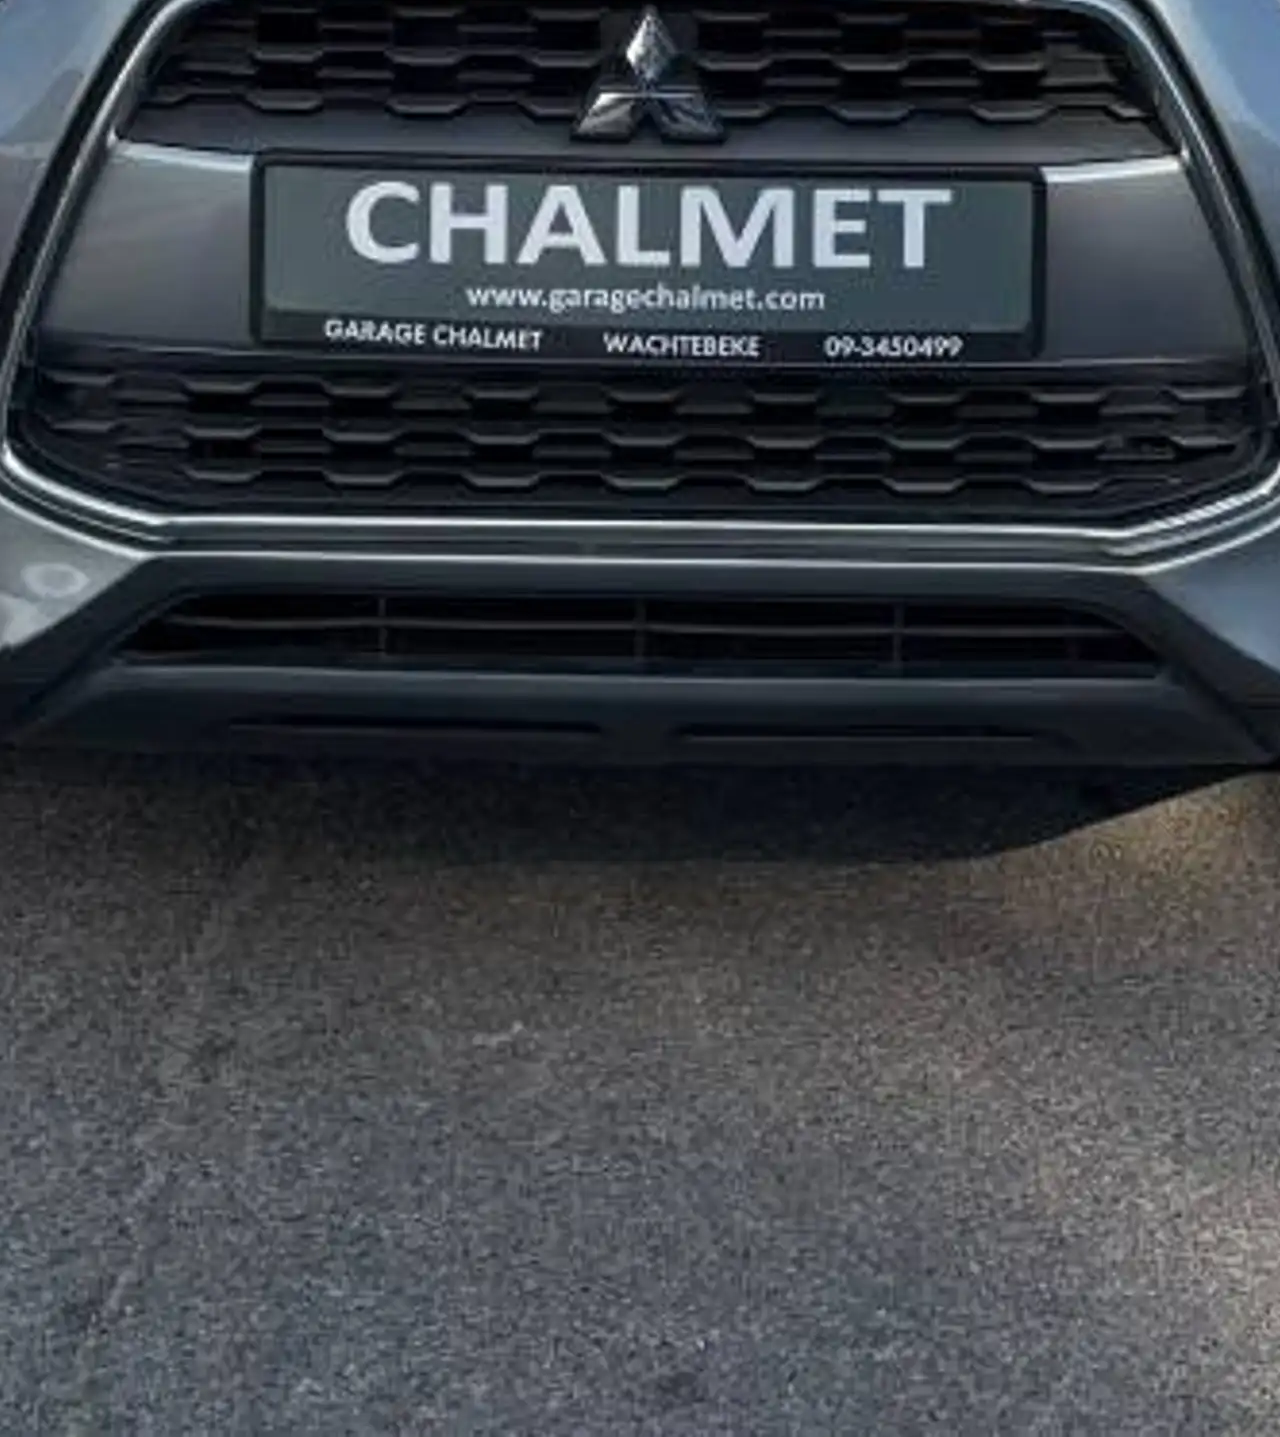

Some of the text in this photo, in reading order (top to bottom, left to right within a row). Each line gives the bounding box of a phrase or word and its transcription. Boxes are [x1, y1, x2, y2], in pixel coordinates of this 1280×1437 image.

[346, 180, 952, 268] CHALMET
[466, 283, 825, 313] www.garagechalmet.com
[324, 319, 963, 357] GARAGE CHALMET WACHTEBEKE 09-3450499
